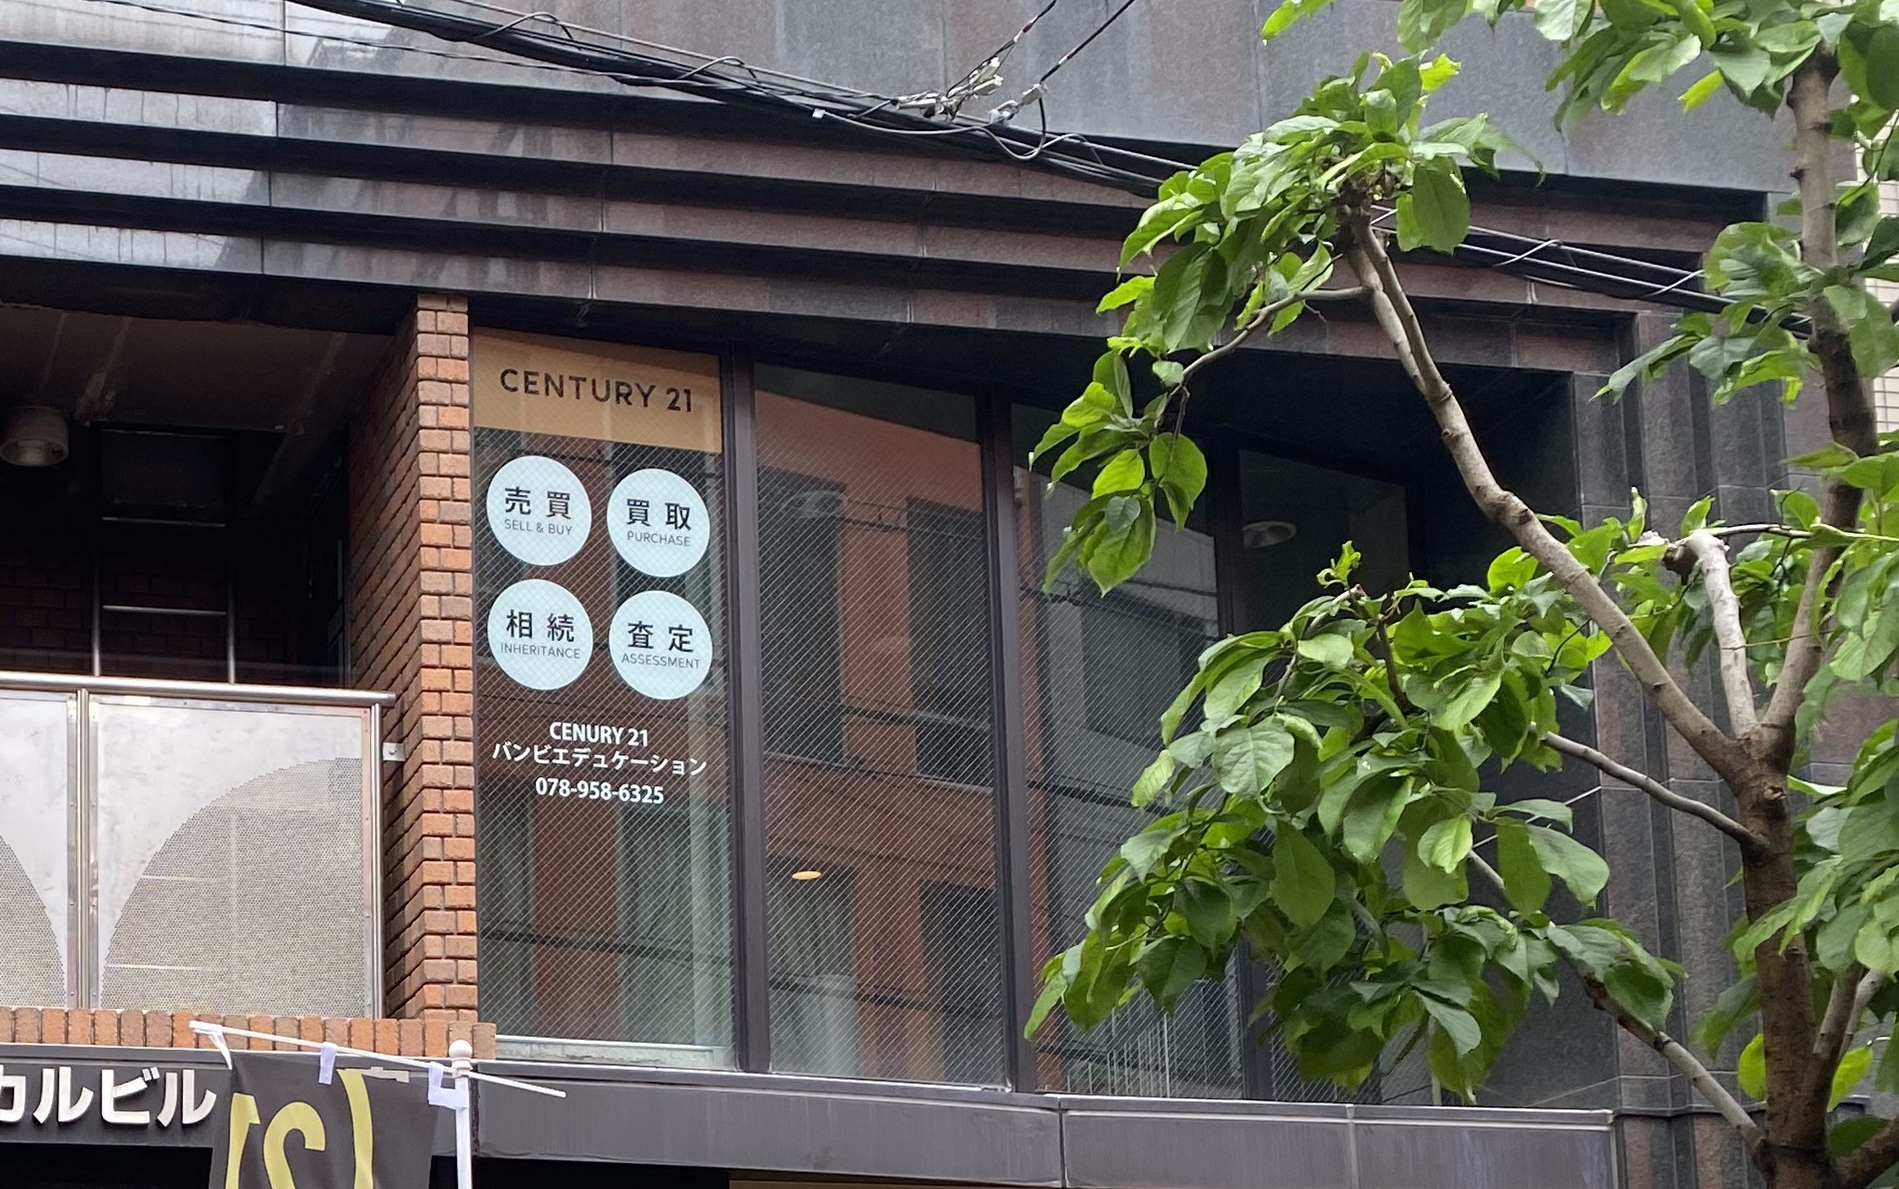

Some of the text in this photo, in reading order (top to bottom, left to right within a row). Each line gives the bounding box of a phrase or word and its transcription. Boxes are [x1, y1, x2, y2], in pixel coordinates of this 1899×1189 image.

[500, 368, 692, 412] CENTURY 21
[504, 486, 572, 520] 売買
[626, 499, 692, 531] 買取
[504, 519, 573, 536] SELL & BUY
[626, 531, 691, 547] PURCHASE
[506, 609, 575, 643] 相続
[627, 621, 694, 653] 査定
[500, 642, 581, 660] INHERITANCE
[621, 653, 701, 670] ASSESSMENT
[549, 721, 649, 747] CENURY 21
[492, 741, 707, 776] バンビエデュケーション
[535, 777, 664, 804] 078-958-6325
